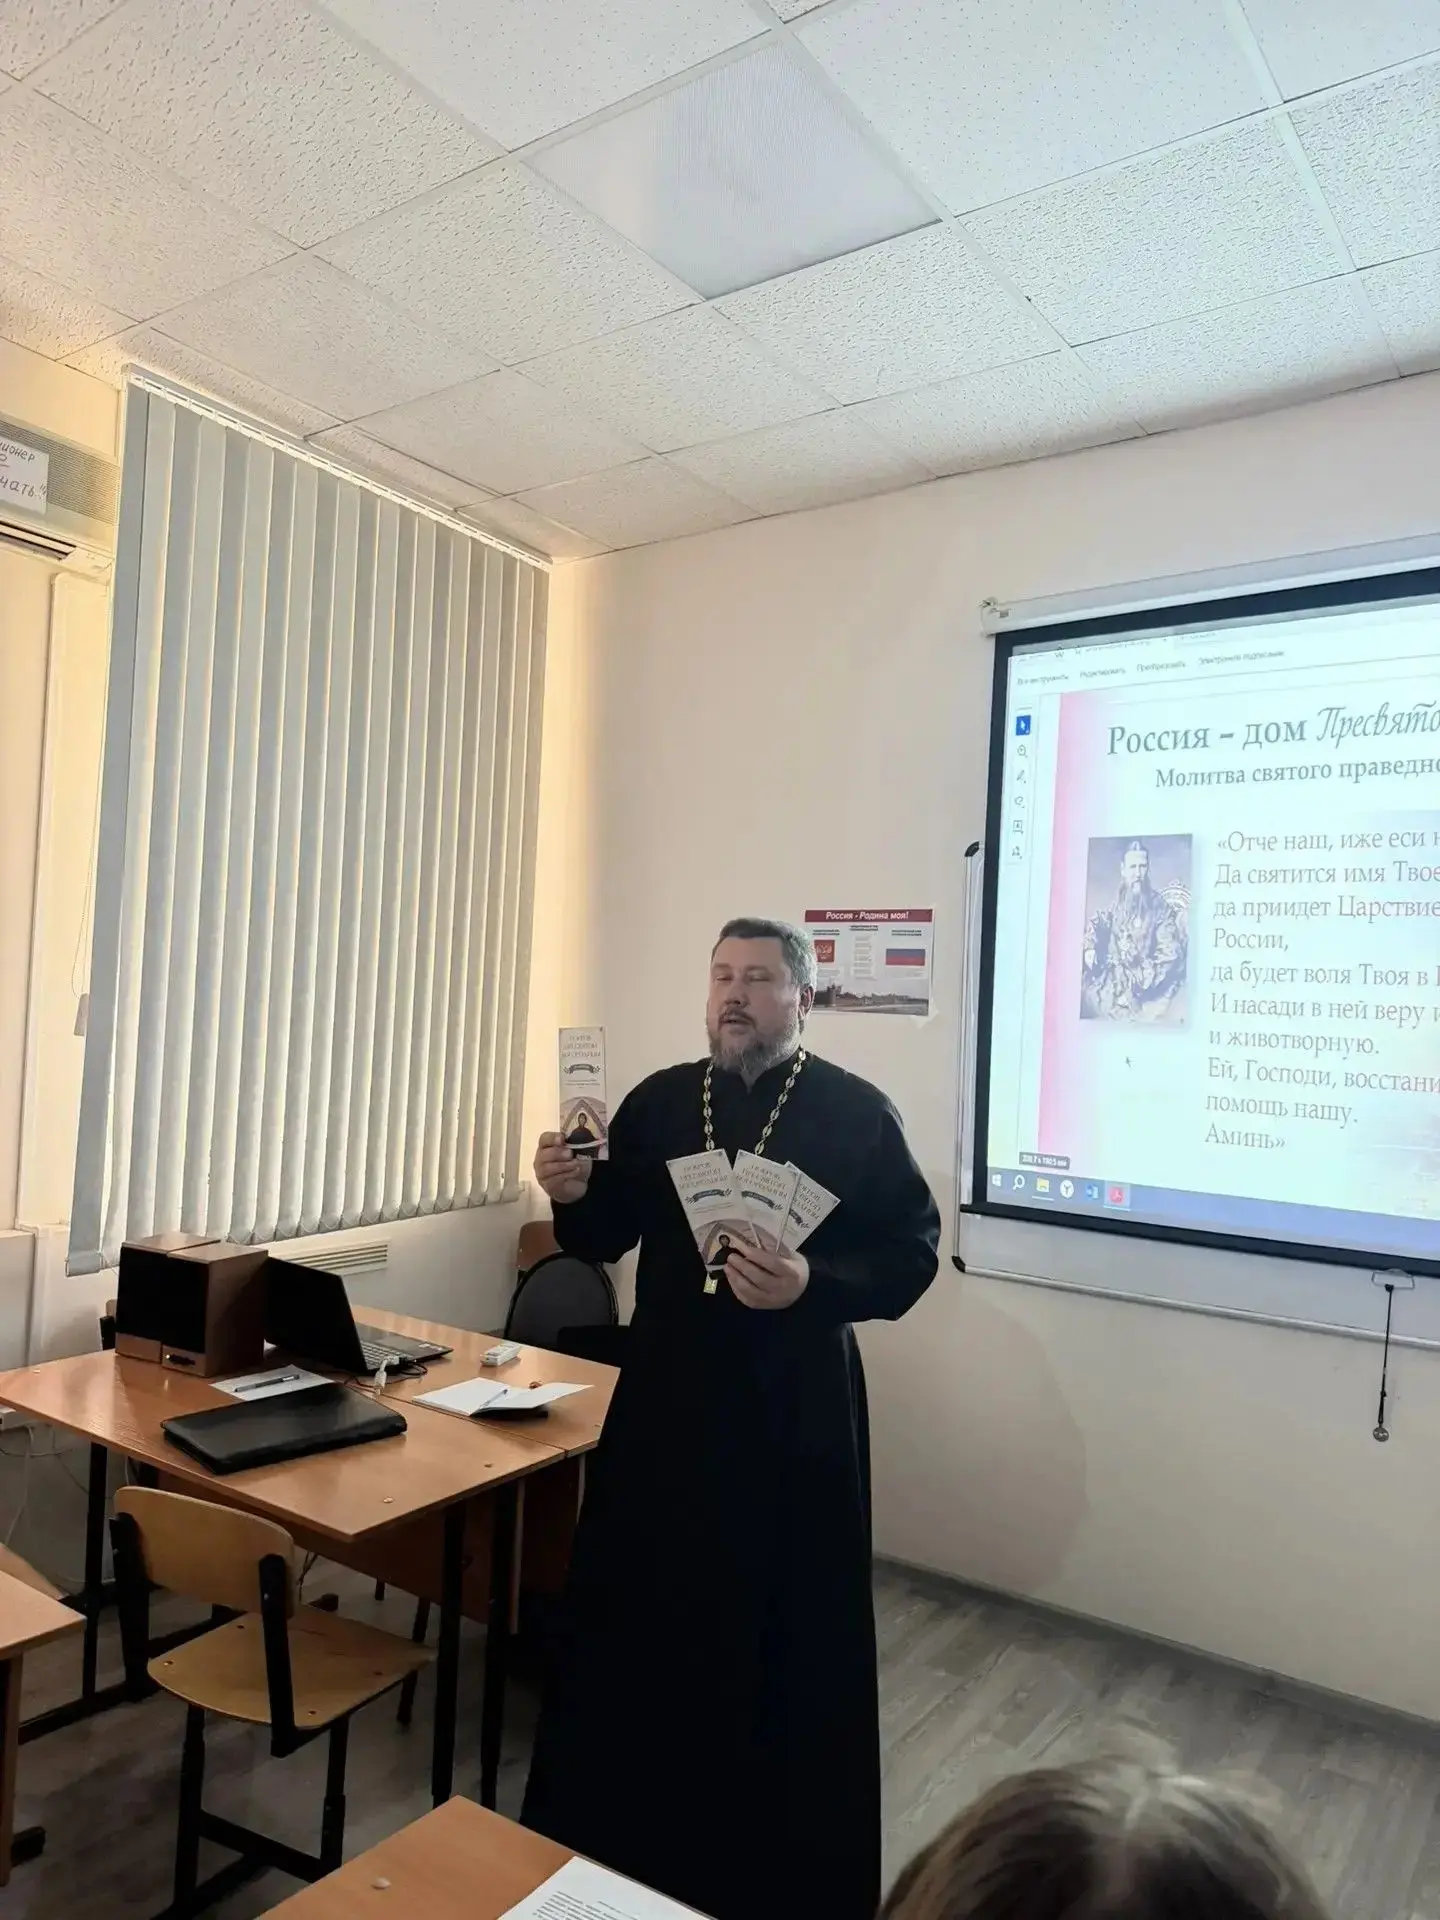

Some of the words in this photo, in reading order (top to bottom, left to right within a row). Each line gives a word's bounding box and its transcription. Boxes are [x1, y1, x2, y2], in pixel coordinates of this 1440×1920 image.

[1107, 726, 1211, 756] Россия
[1241, 719, 1308, 751] дом
[1155, 767, 1246, 788] Молитва
[1251, 763, 1333, 783] святого
[1217, 830, 1279, 853] «Отче
[1283, 833, 1334, 853] наш,
[1340, 832, 1383, 849] иже
[1388, 831, 1425, 848] еси
[1213, 863, 1243, 888] Да
[1247, 867, 1337, 885] святится
[1343, 867, 1386, 883] имя
[1392, 860, 1440, 883] Твое
[825, 911, 853, 920] Россия
[859, 911, 888, 921] Родина
[890, 911, 909, 920] моя!
[1212, 901, 1237, 920] да
[1242, 900, 1332, 924] приидет
[1337, 894, 1440, 925] Царствие
[1213, 927, 1289, 952] России,
[1210, 965, 1234, 984] да
[1239, 959, 1300, 989] будет
[1303, 967, 1353, 985] воля
[1358, 963, 1410, 986] Твоя
[1416, 970, 1429, 987] в
[1211, 992, 1228, 1014] И
[1232, 999, 1304, 1020] насади
[1311, 1001, 1322, 1017] в
[1328, 999, 1369, 1020] ней
[1374, 1004, 1426, 1030] веру
[1209, 1030, 1221, 1045] и
[1226, 1031, 1380, 1060] животворную.
[1207, 1056, 1239, 1083] Ей,
[1245, 1058, 1337, 1090] Господи,
[1343, 1071, 1440, 1094] восстани
[1205, 1095, 1289, 1118] помощь
[1292, 1102, 1358, 1130] нашу.
[1204, 1122, 1286, 1149] Аминь»
